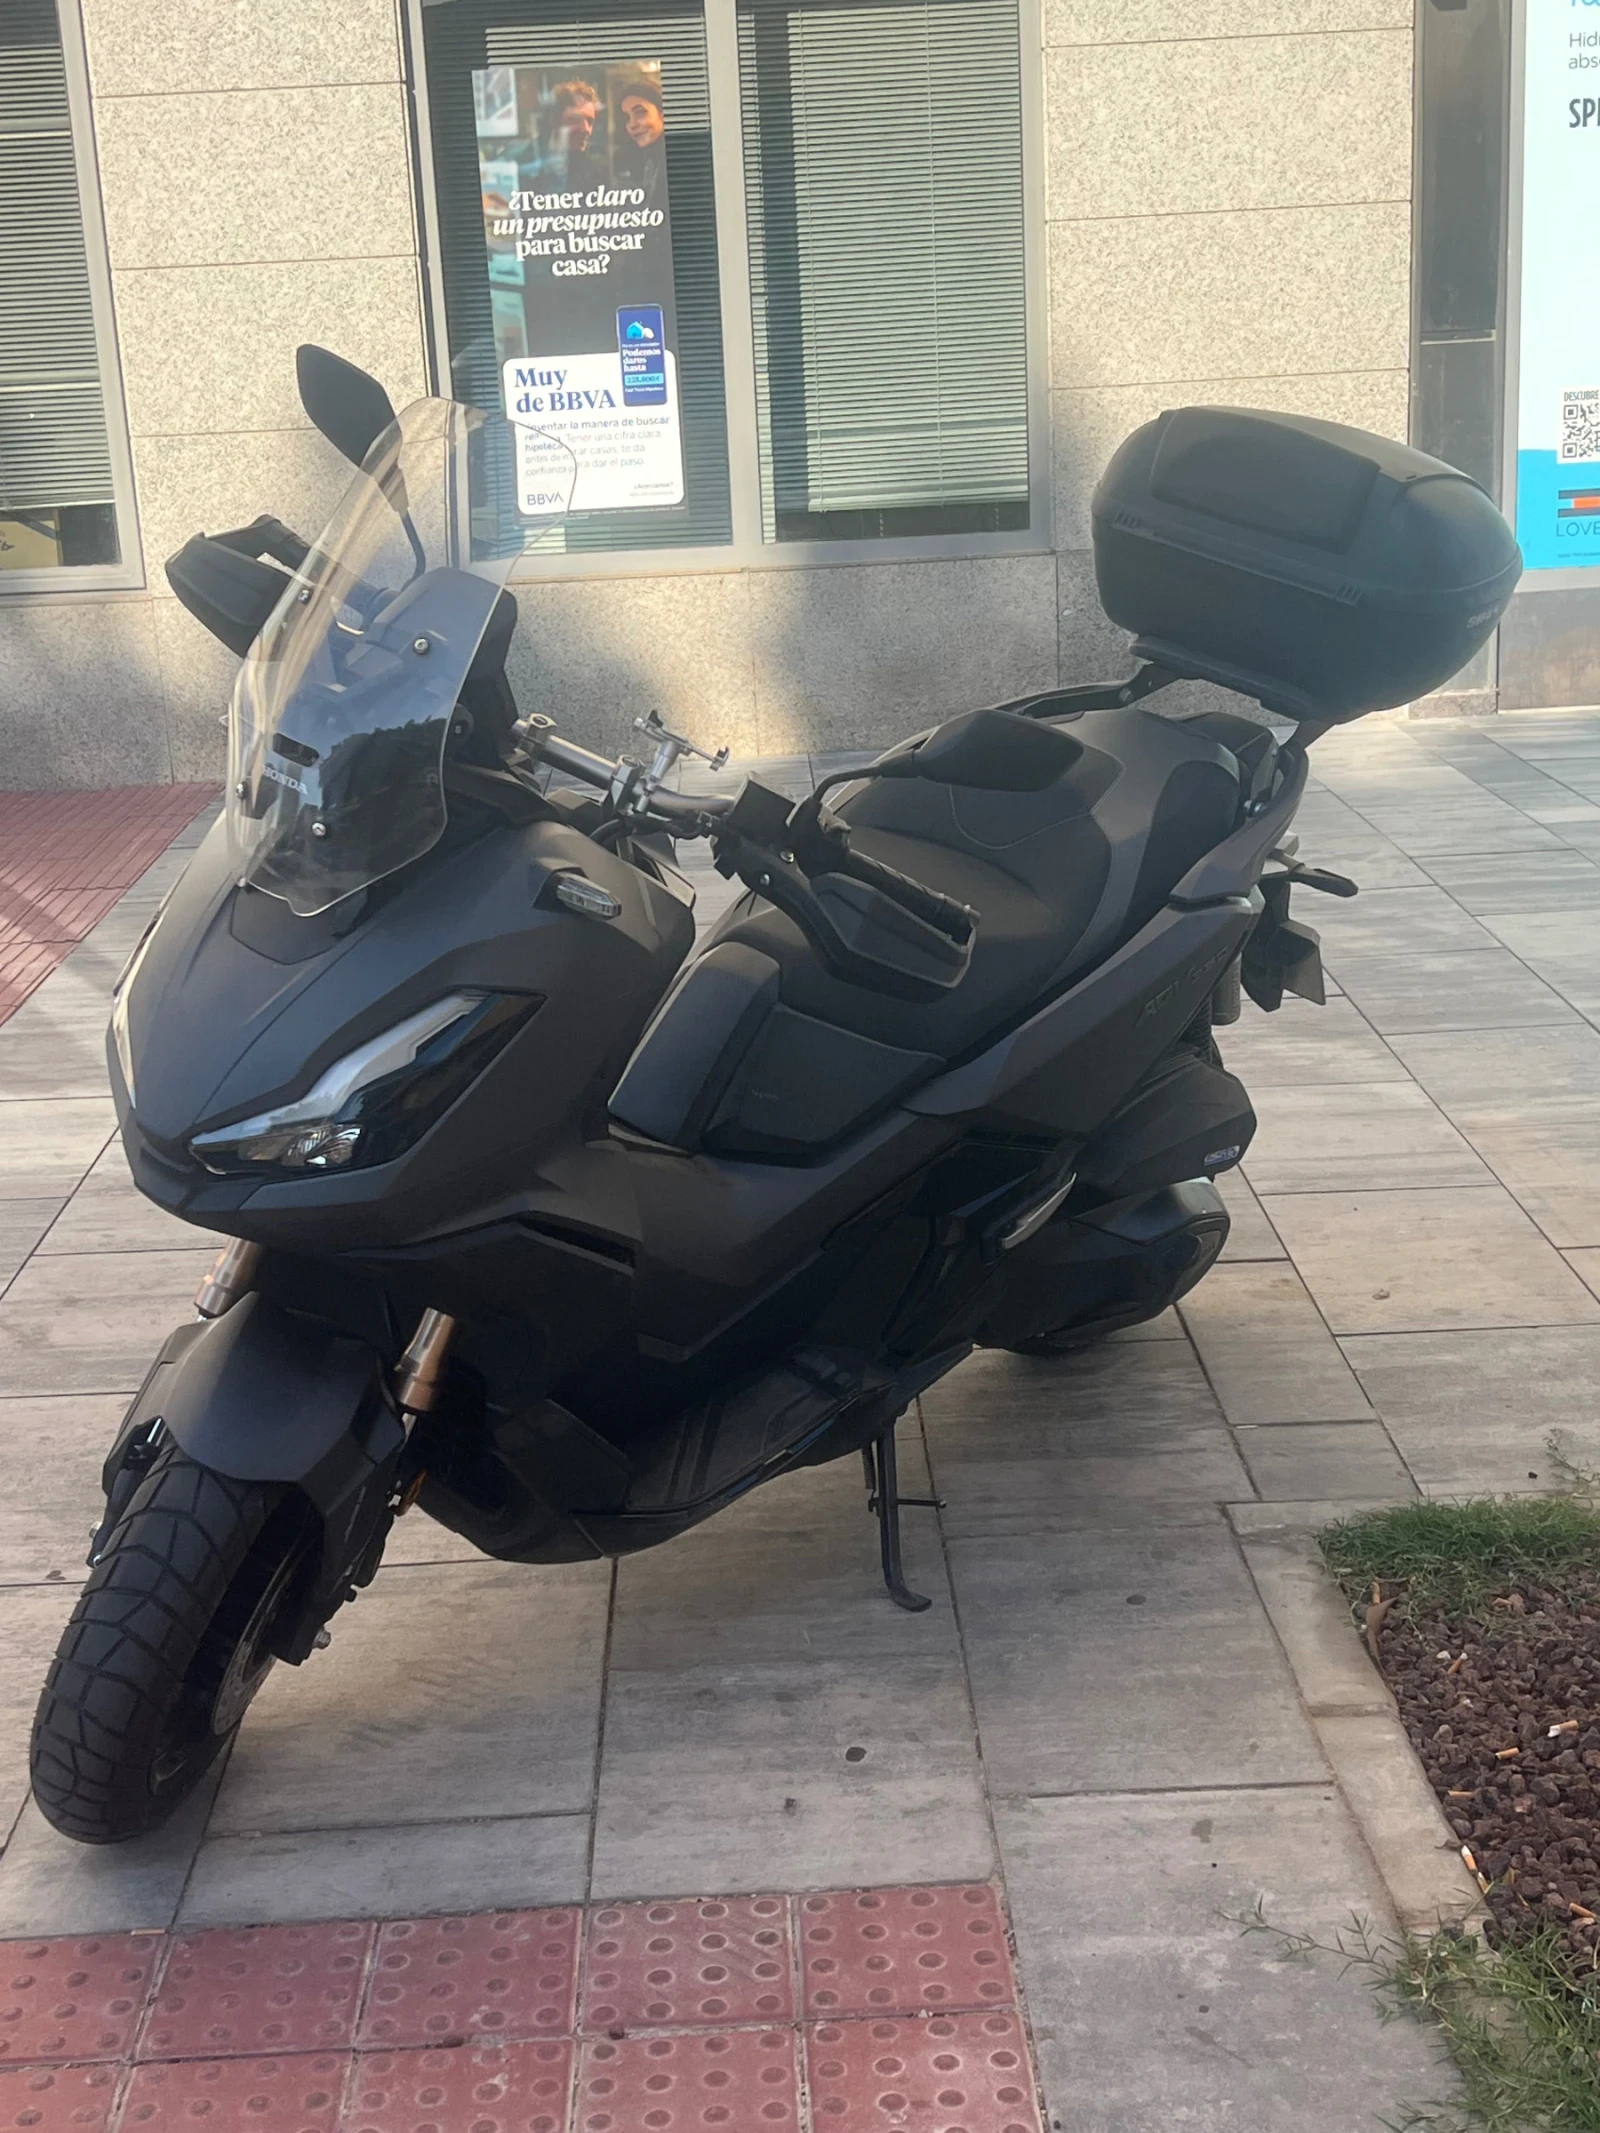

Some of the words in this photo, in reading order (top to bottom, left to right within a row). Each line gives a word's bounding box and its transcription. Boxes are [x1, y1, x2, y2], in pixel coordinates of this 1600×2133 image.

[1569, 31, 1600, 48] Hid
[1568, 53, 1600, 69] abs
[508, 190, 583, 211] ¿Tener
[585, 185, 645, 207] claro
[493, 218, 525, 235] un
[525, 208, 664, 239] presupuesto
[515, 238, 567, 262] para
[568, 232, 645, 254] buscar
[551, 253, 610, 276] casa?
[514, 368, 568, 390] Muy
[516, 392, 544, 413] de
[549, 389, 616, 412] BBVA
[1563, 389, 1599, 402] DESCUBRE
[570, 420, 579, 429] la
[581, 419, 619, 429] manera
[621, 418, 634, 426] de
[636, 416, 670, 426] buscar
[565, 433, 592, 443] Tener
[594, 433, 612, 441] una
[614, 431, 636, 440] cifra
[637, 430, 661, 439] clara
[525, 455, 549, 464] antes
[550, 453, 561, 462] de
[621, 444, 631, 453] te
[633, 443, 645, 452] da
[592, 459, 607, 468] dar
[609, 458, 618, 467] el
[526, 491, 565, 506] BBVA
[262, 766, 308, 796] HONDA
